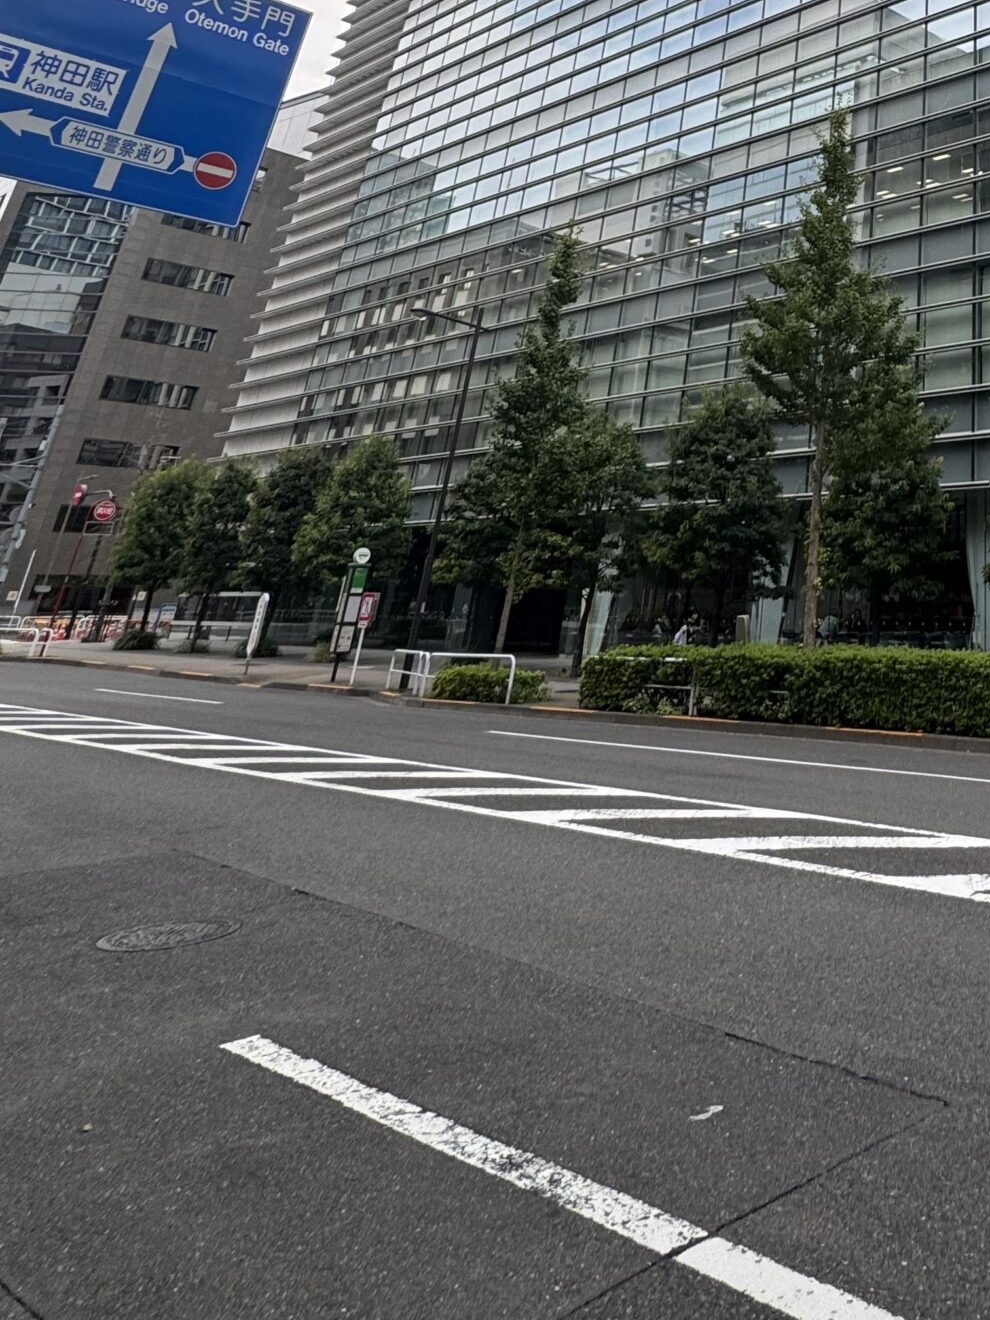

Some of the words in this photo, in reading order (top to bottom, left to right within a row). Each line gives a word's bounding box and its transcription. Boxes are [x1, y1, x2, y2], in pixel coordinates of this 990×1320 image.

[184, 8, 248, 42] Otemon
[252, 32, 290, 56] Gate
[22, 76, 75, 102] Kanda
[79, 92, 108, 112] Sta.
[30, 50, 119, 96] 神田駅
[69, 126, 167, 164] 神田警察通り
